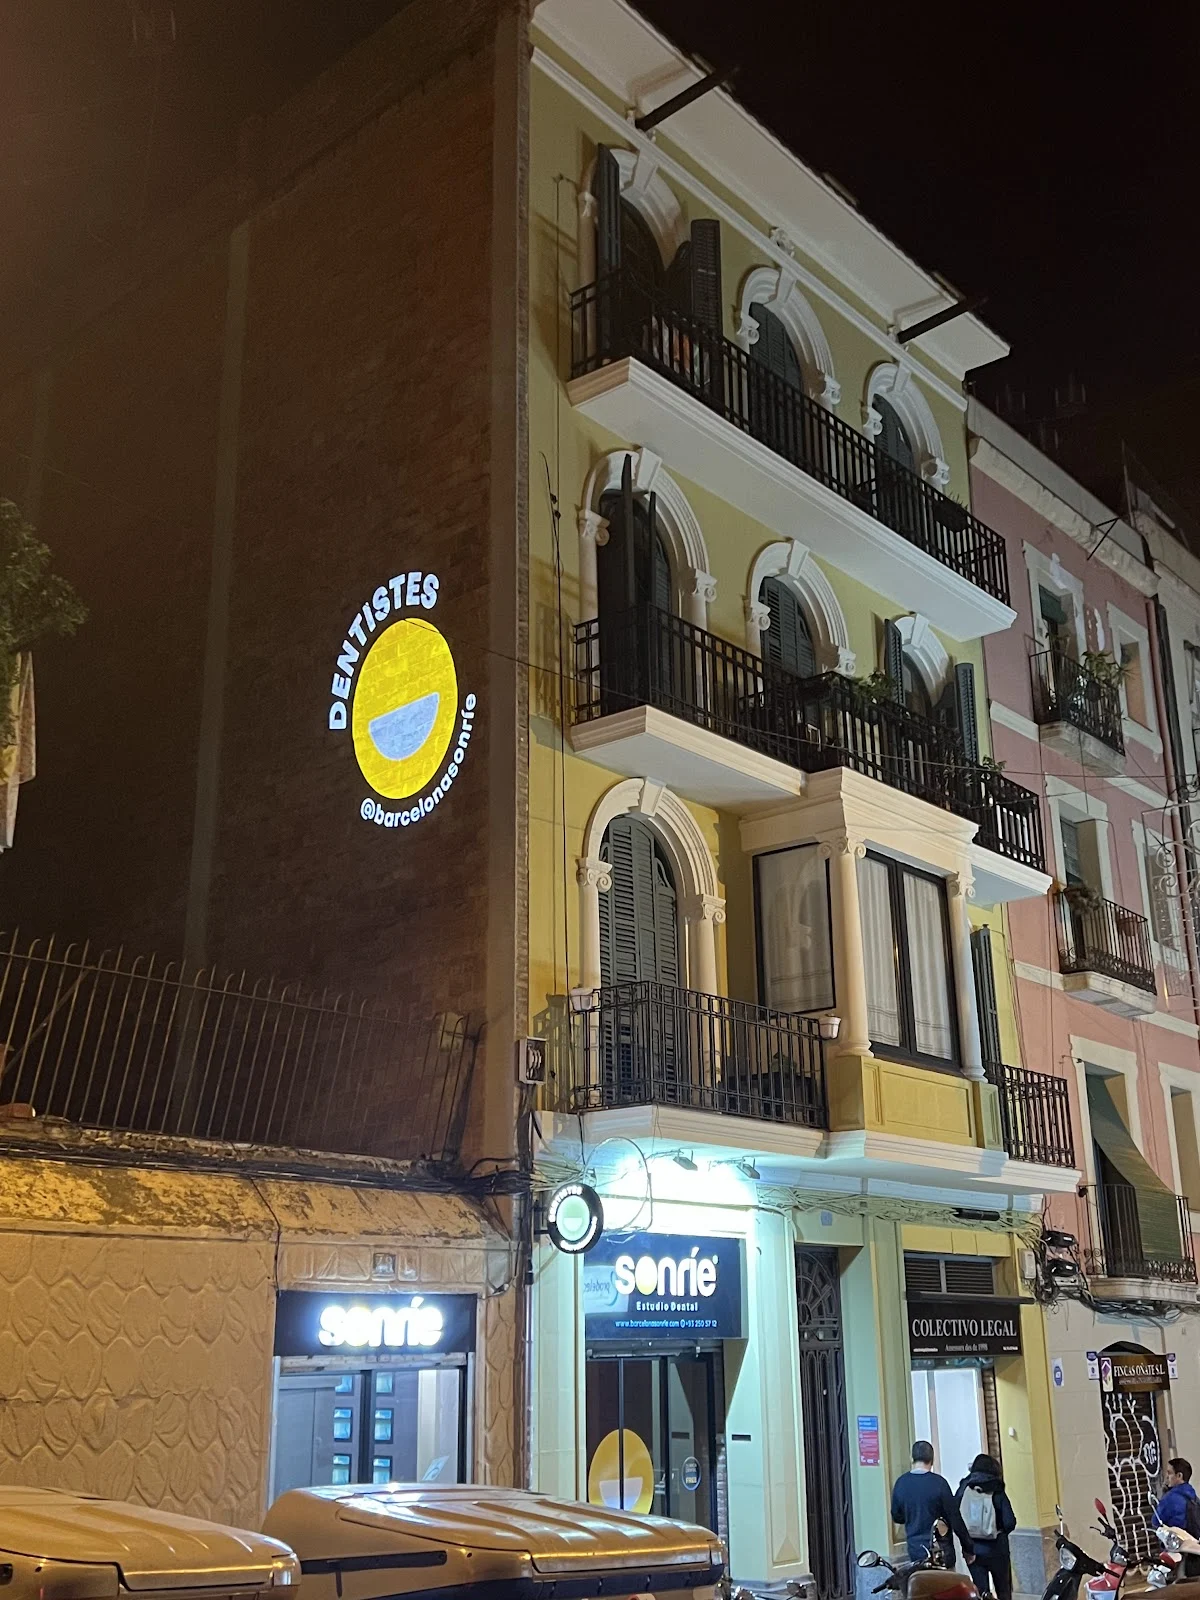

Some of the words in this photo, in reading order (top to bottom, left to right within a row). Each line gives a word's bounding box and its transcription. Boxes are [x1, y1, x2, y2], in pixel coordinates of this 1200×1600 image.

[328, 571, 440, 730] DENTISTES
[615, 1247, 717, 1297] sonríe
[636, 1301, 669, 1311] Estudio
[670, 1302, 698, 1311] Dental
[912, 1319, 978, 1337] COLECTIVO
[981, 1320, 1017, 1336] LEGAL
[1114, 1364, 1135, 1376] FINCAS
[1136, 1362, 1155, 1375] OÑATE
